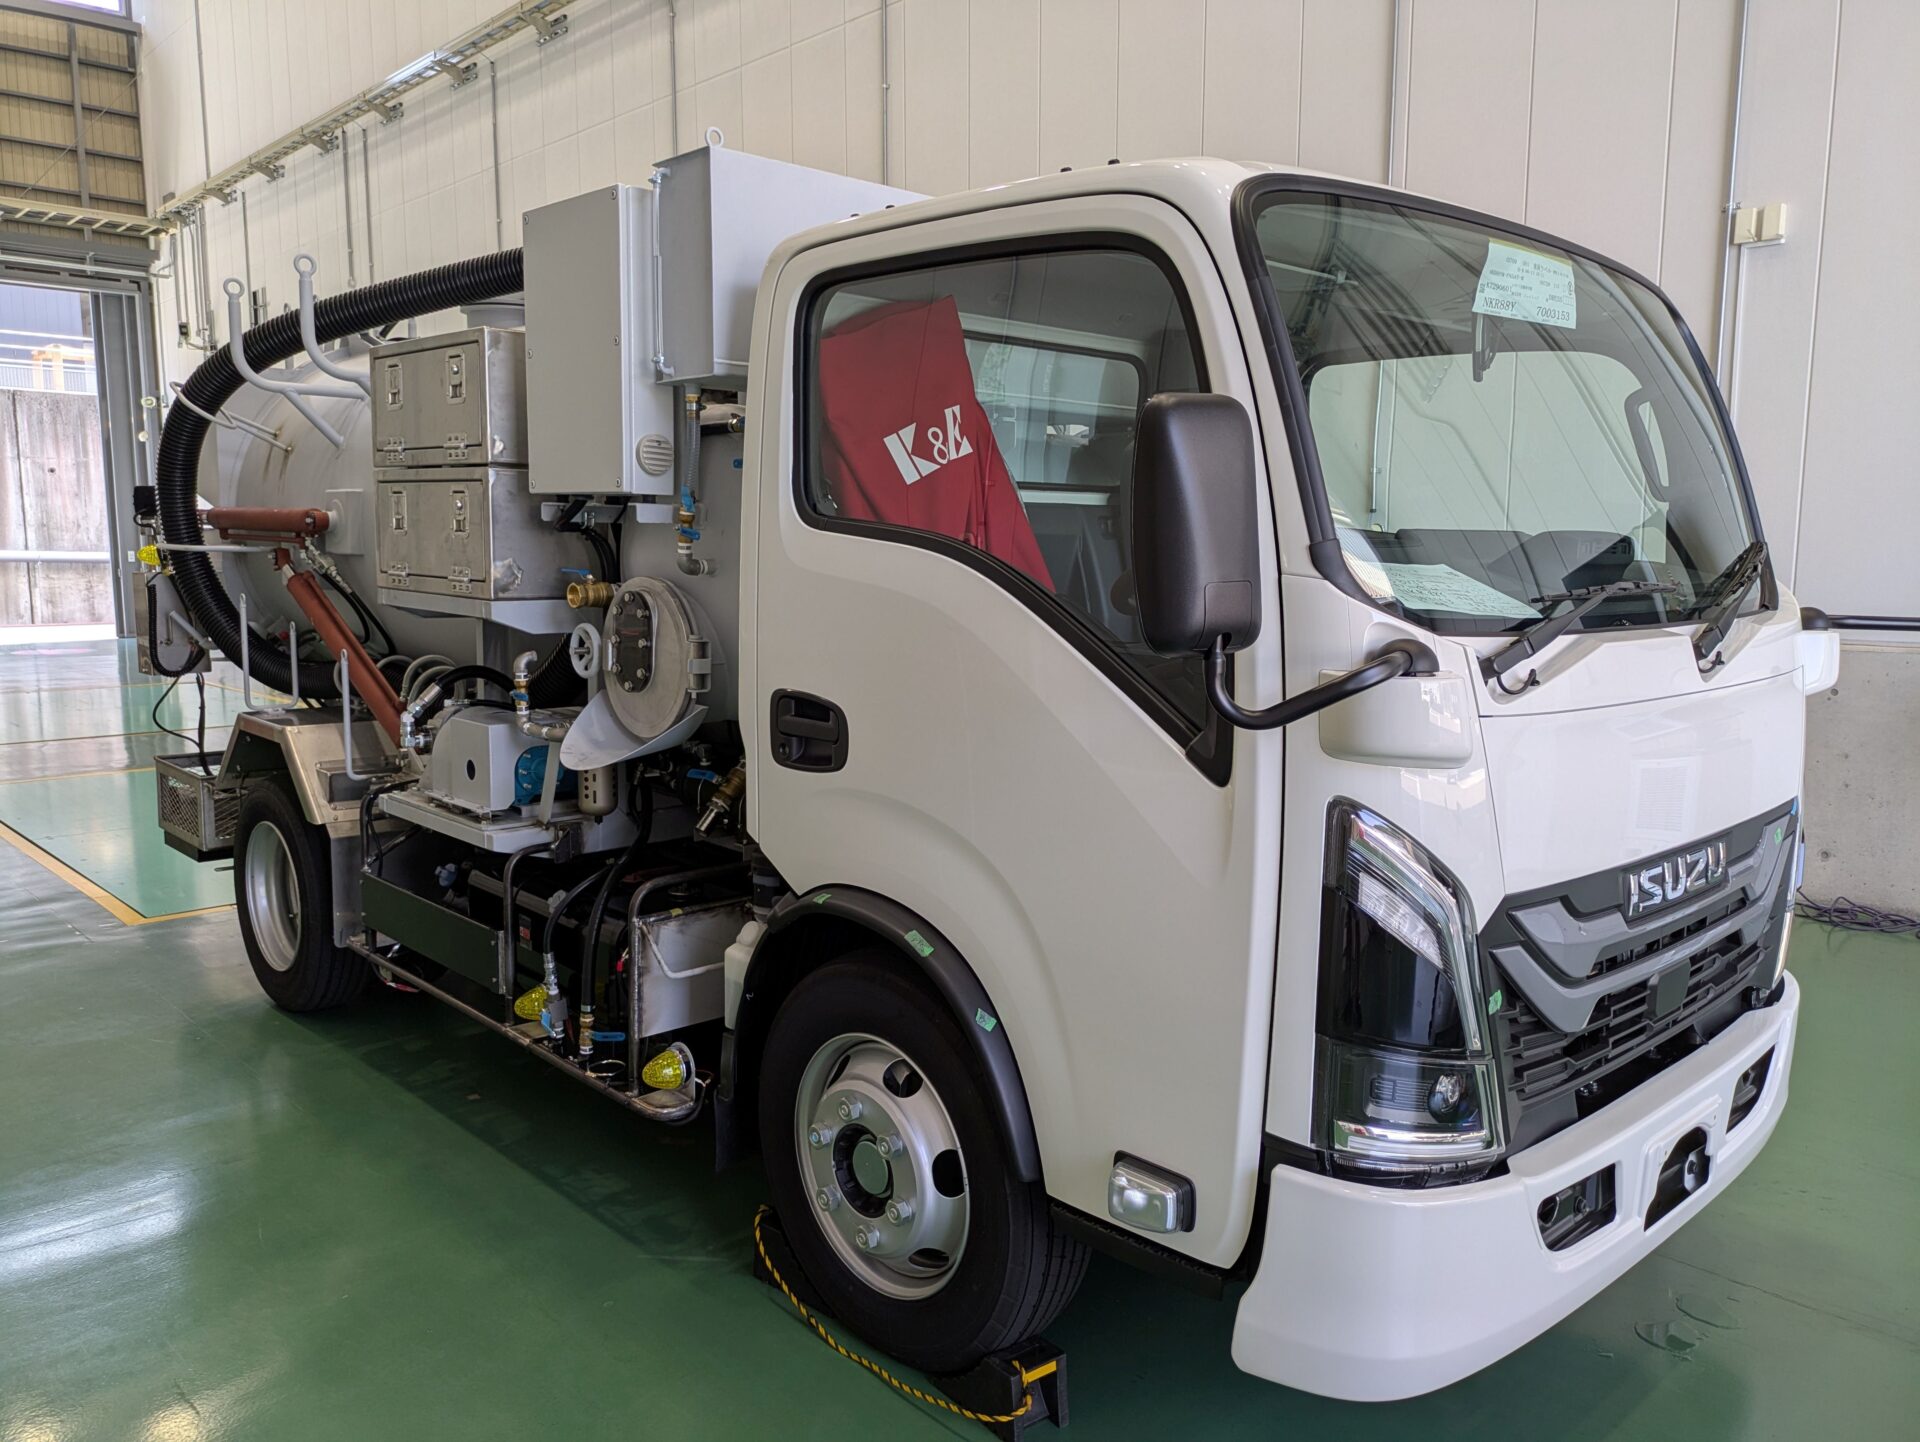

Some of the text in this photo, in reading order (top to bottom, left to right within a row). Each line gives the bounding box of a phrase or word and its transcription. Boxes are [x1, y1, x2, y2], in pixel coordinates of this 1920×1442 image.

[1483, 297, 1517, 312] NKR88Y
[1536, 306, 1570, 321] 7003153
[1628, 841, 1727, 917] ISUZU
